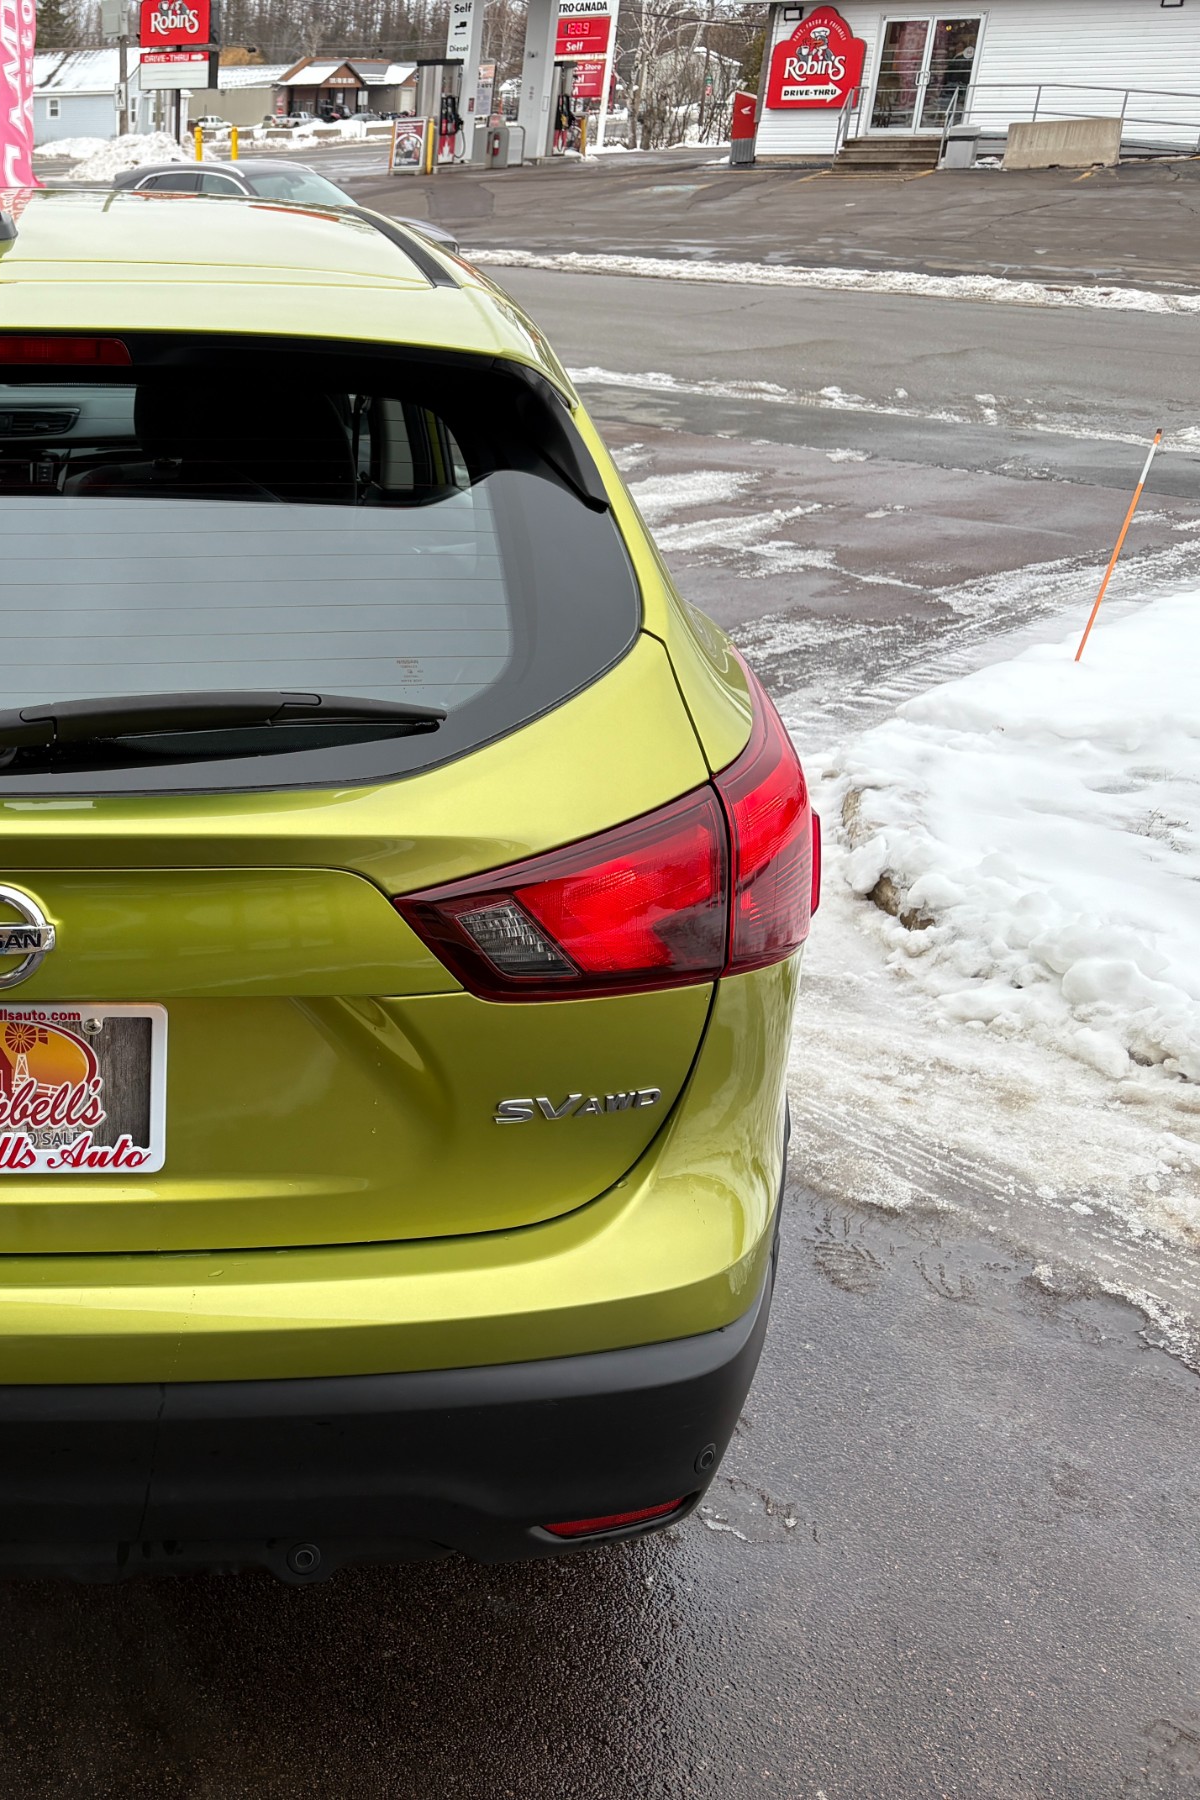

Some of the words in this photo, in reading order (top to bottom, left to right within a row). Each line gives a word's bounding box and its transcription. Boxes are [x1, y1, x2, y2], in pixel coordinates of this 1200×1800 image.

[453, 3, 472, 13] Self
[449, 44, 469, 52] Diesel
[566, 41, 584, 51] Self
[144, 54, 189, 63] DRIVE-THRU
[783, 88, 837, 97] DRIVE-THRU
[493, 1093, 582, 1124] SV
[572, 1088, 661, 1117] AWD
[47, 1135, 152, 1169] Auto
